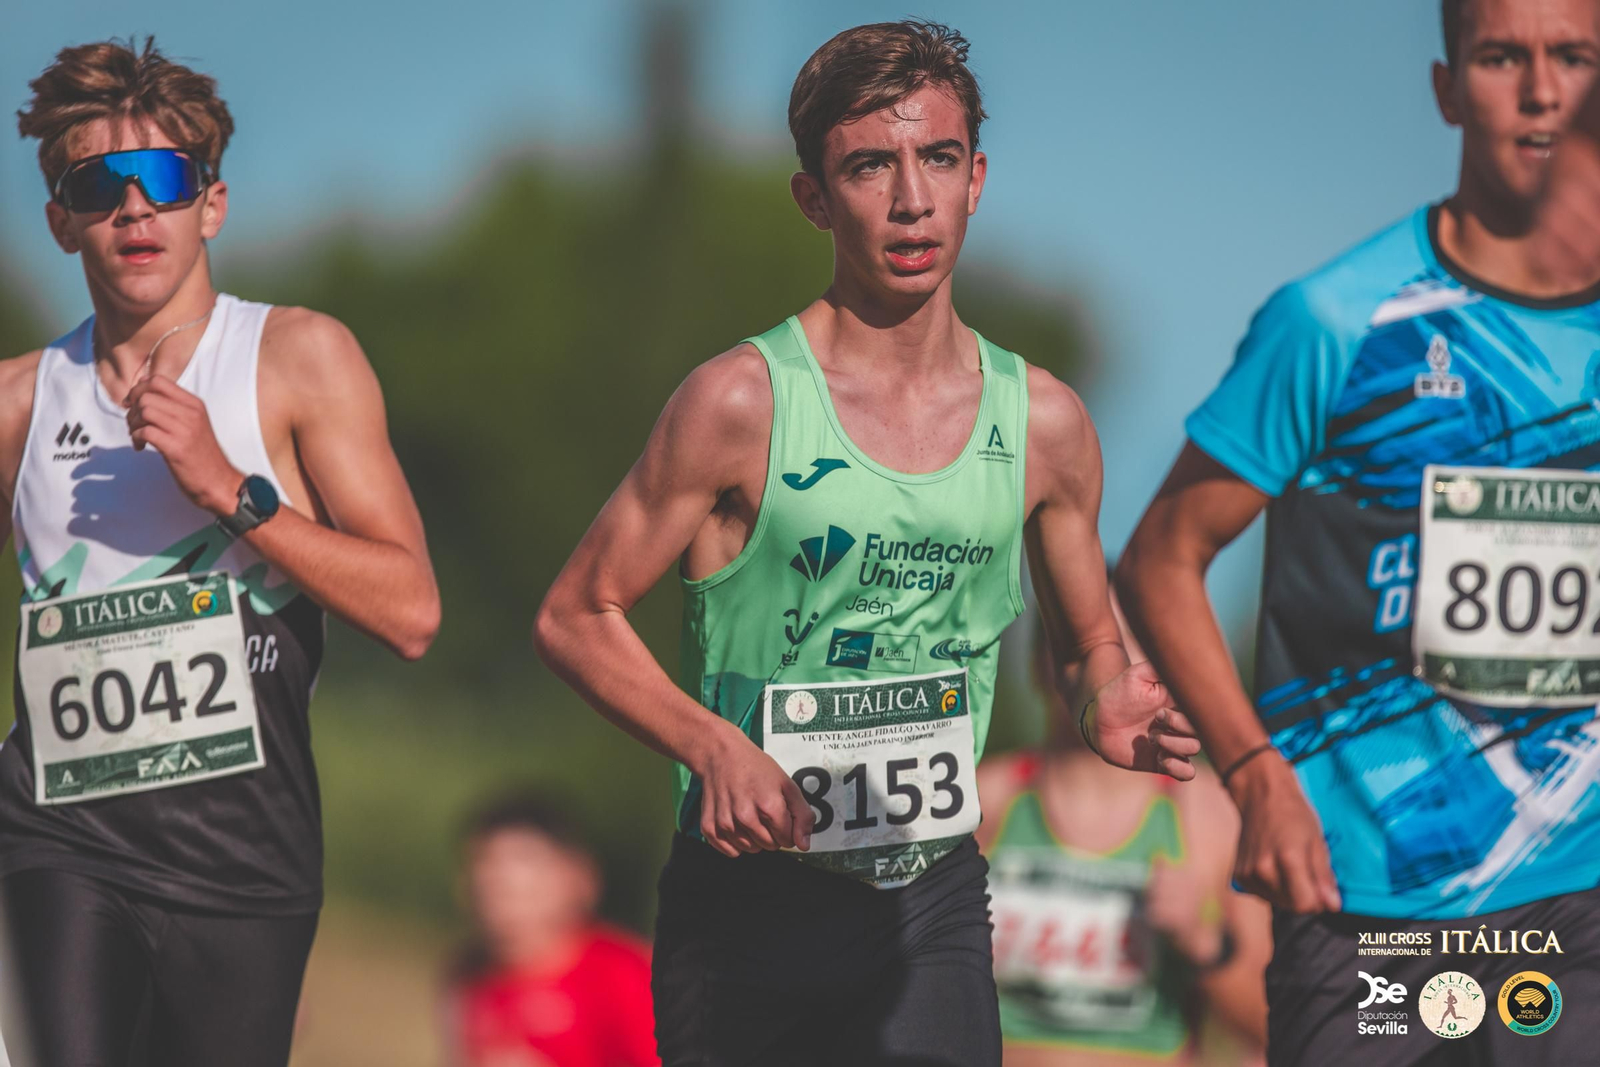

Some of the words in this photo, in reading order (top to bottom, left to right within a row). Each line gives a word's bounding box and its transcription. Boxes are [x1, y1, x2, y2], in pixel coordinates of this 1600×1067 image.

[863, 533, 994, 566] Fundación
[858, 561, 955, 592] Unicaja
[74, 589, 177, 627] ITÁLICA
[845, 594, 894, 617] Jaén
[1444, 562, 1600, 636] 809
[50, 652, 238, 742] 6042
[833, 686, 929, 717] ITÁLICA
[801, 732, 845, 743] VICENTE
[845, 731, 875, 741] ANGEL
[875, 726, 914, 738] FIDALGO
[914, 719, 952, 732] NAVARRO
[823, 742, 856, 751] UNICAJA
[856, 740, 873, 749] JAEN
[137, 751, 203, 779] FAA
[791, 751, 964, 835] 8153
[874, 853, 928, 877] FAA
